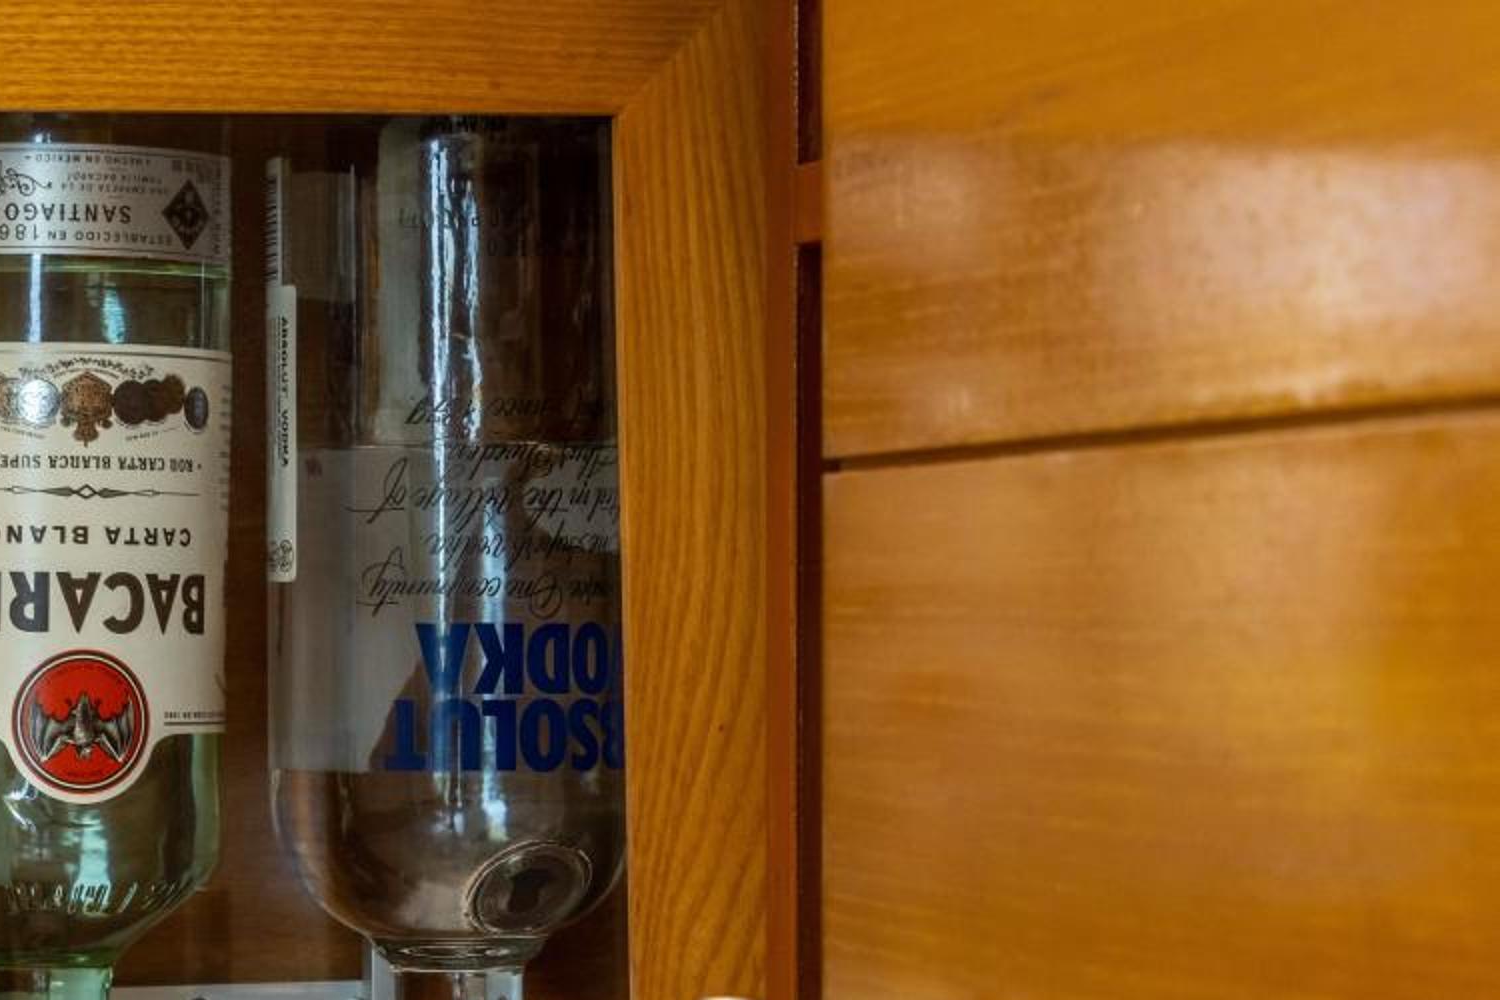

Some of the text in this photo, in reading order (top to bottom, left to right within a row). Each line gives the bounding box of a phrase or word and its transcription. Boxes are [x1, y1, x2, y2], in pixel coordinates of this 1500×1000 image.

[3, 202, 132, 225] SANTIAGO
[47, 229, 67, 240] EN
[74, 231, 173, 245] ESTABLECIDO
[47, 454, 111, 470] BLANCA
[118, 457, 165, 472] CARTA
[347, 457, 407, 524] of
[103, 525, 191, 547] CARTA
